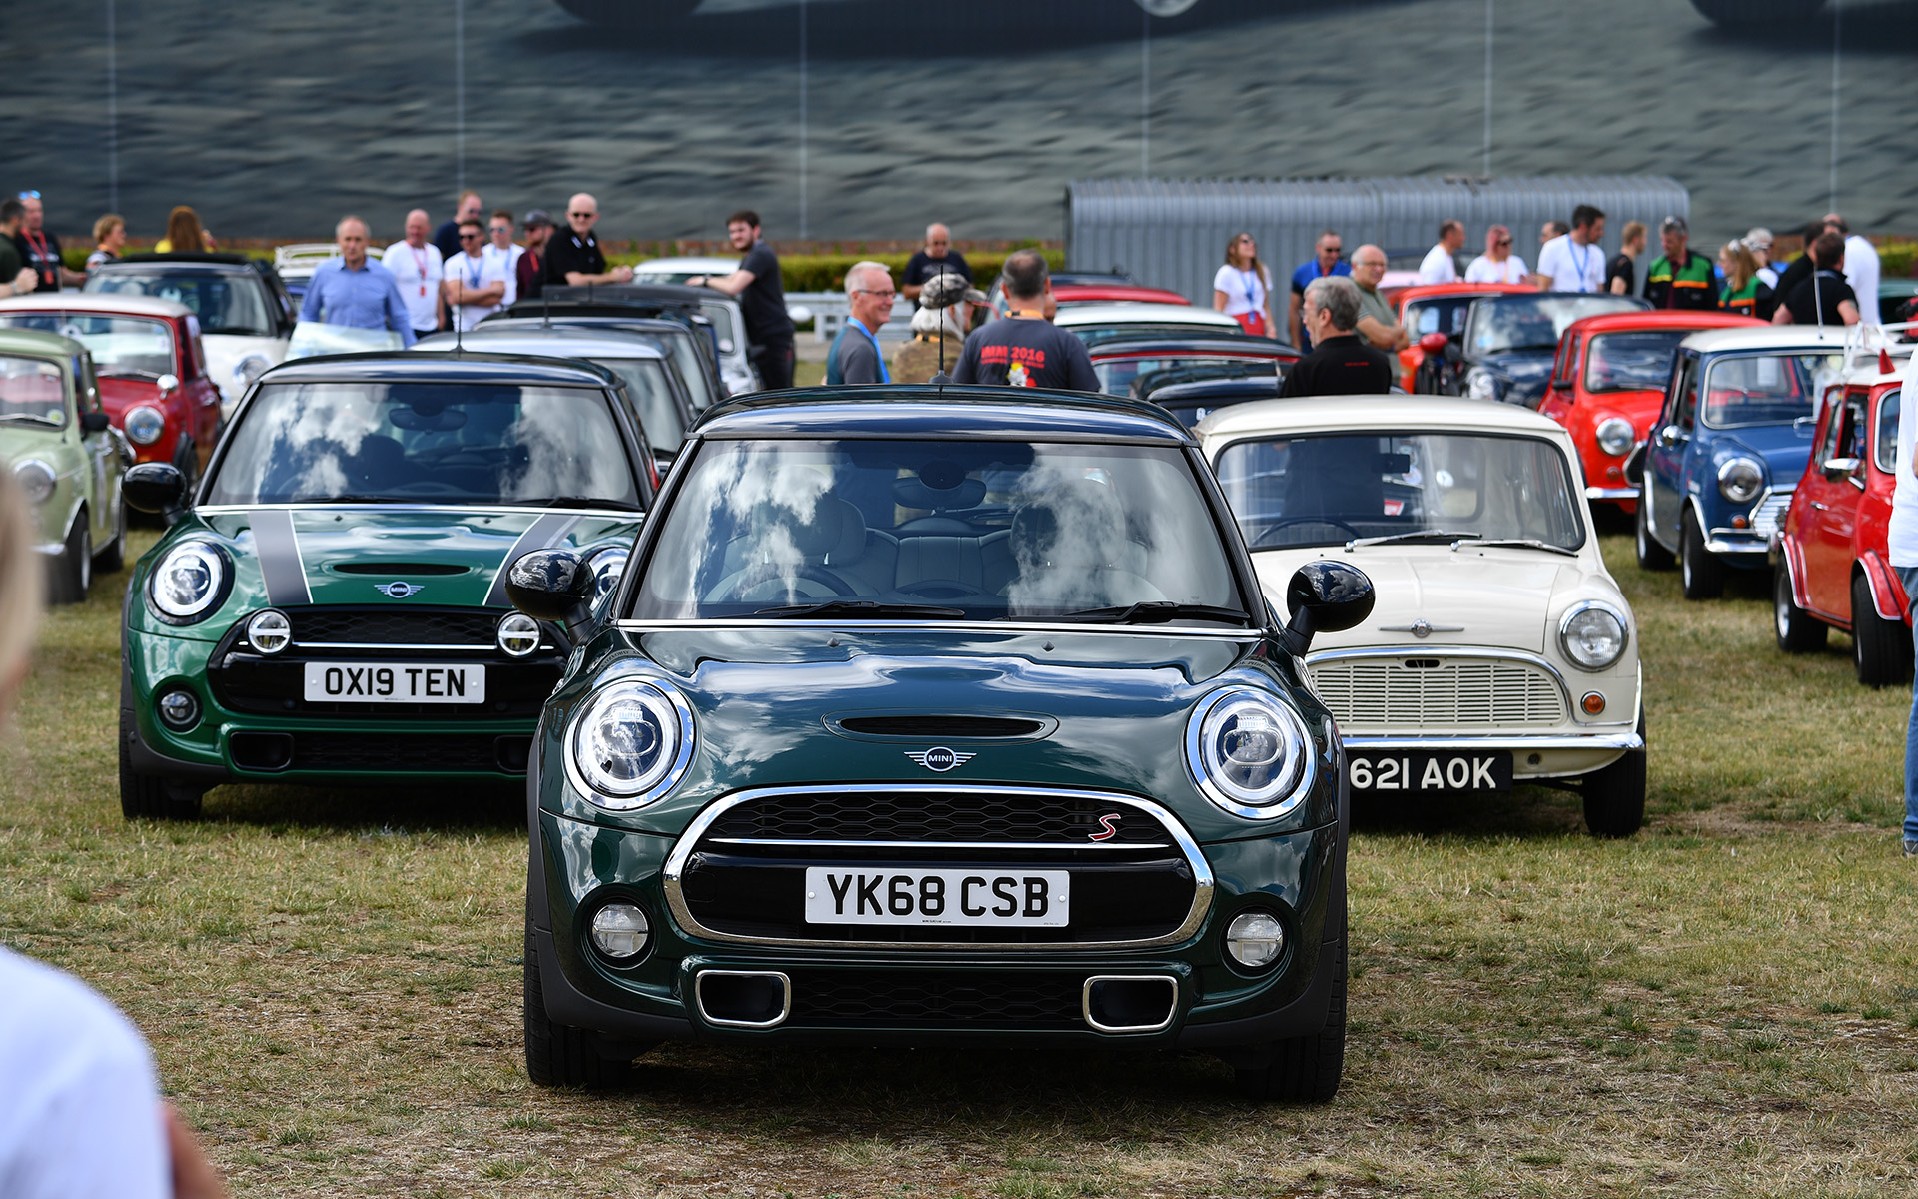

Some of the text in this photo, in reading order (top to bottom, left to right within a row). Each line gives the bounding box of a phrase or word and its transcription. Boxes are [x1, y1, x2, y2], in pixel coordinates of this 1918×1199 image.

[1011, 346, 1045, 363] 2016
[325, 667, 465, 697] OX19 TEN
[928, 754, 953, 762] MINI
[1349, 757, 1496, 790] 621 AOK
[1088, 812, 1121, 842] S
[826, 873, 1049, 918] YK68 CSB
